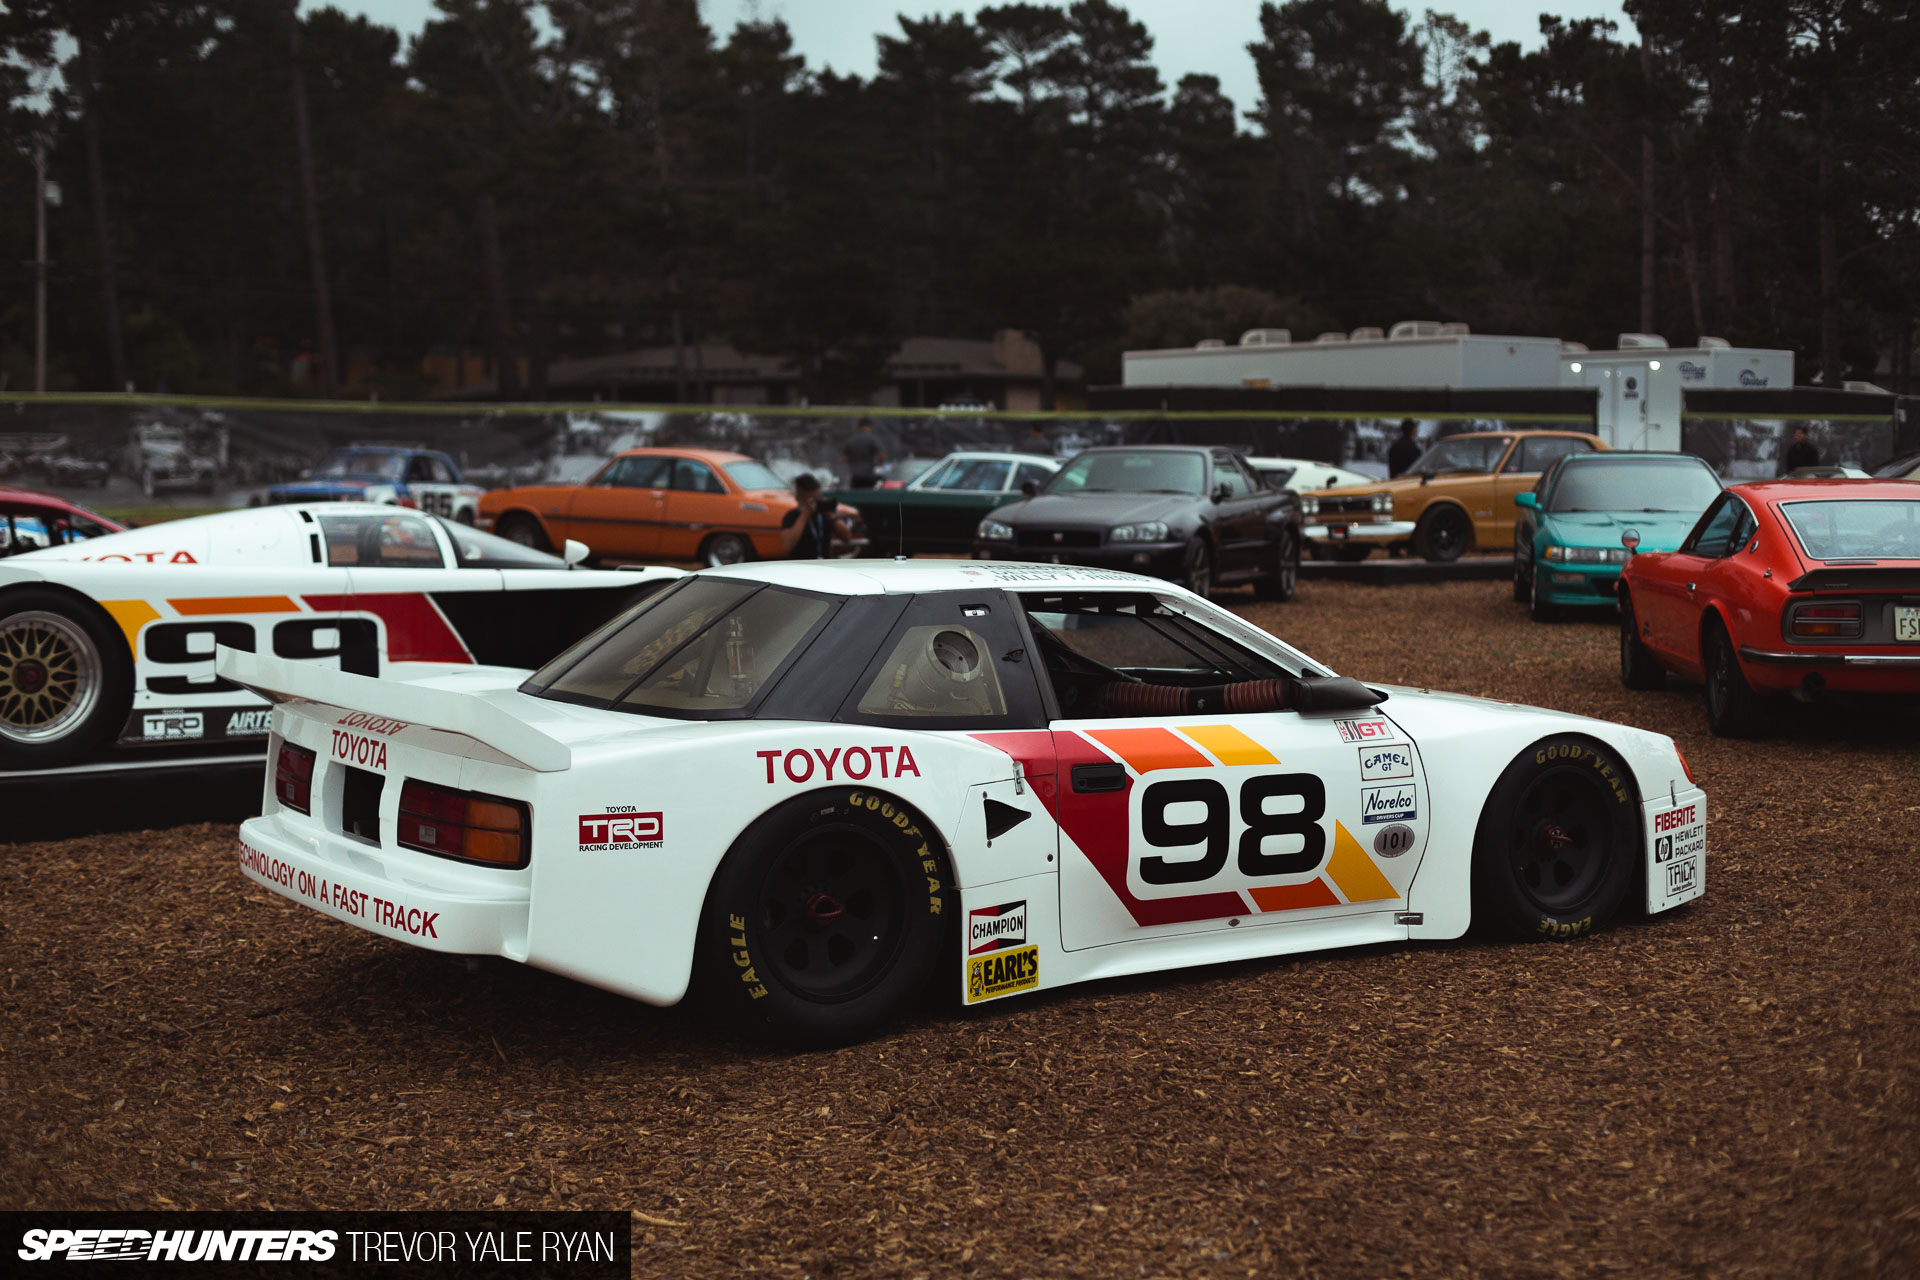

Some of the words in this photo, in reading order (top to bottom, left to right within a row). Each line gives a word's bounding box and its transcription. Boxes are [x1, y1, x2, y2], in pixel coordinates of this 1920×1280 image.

[1899, 617, 1920, 636] FS
[145, 616, 379, 695] 99
[146, 716, 200, 736] TRD
[226, 711, 273, 731] AIRTE
[1357, 721, 1385, 737] GT
[332, 729, 387, 770] TOYOTA
[1364, 752, 1409, 769] CAMEL
[756, 745, 921, 784] TOYOTA
[1381, 763, 1392, 772] GT
[605, 805, 637, 813] TOYOTA
[1364, 789, 1411, 814] Norelco
[582, 817, 660, 843] TRD
[1139, 772, 1326, 885] 98
[1655, 804, 1696, 833] FIBERITE
[1382, 831, 1407, 850] 101
[1675, 825, 1703, 843] HEWLETT
[579, 843, 607, 852] RACING
[609, 841, 664, 851] DEVELOPMENT
[1675, 839, 1703, 858] PACKARD
[1668, 859, 1696, 886] TRICK
[238, 840, 295, 890] ECHNOLOGY
[298, 870, 316, 899] ON
[320, 879, 329, 904] A
[333, 883, 369, 918] FAST
[373, 897, 440, 939] TRACK
[972, 915, 1024, 940] CHAMPION
[1536, 916, 1592, 938] EAGLE
[729, 913, 769, 1000] EAGLE
[983, 948, 1038, 987] EARL'S
